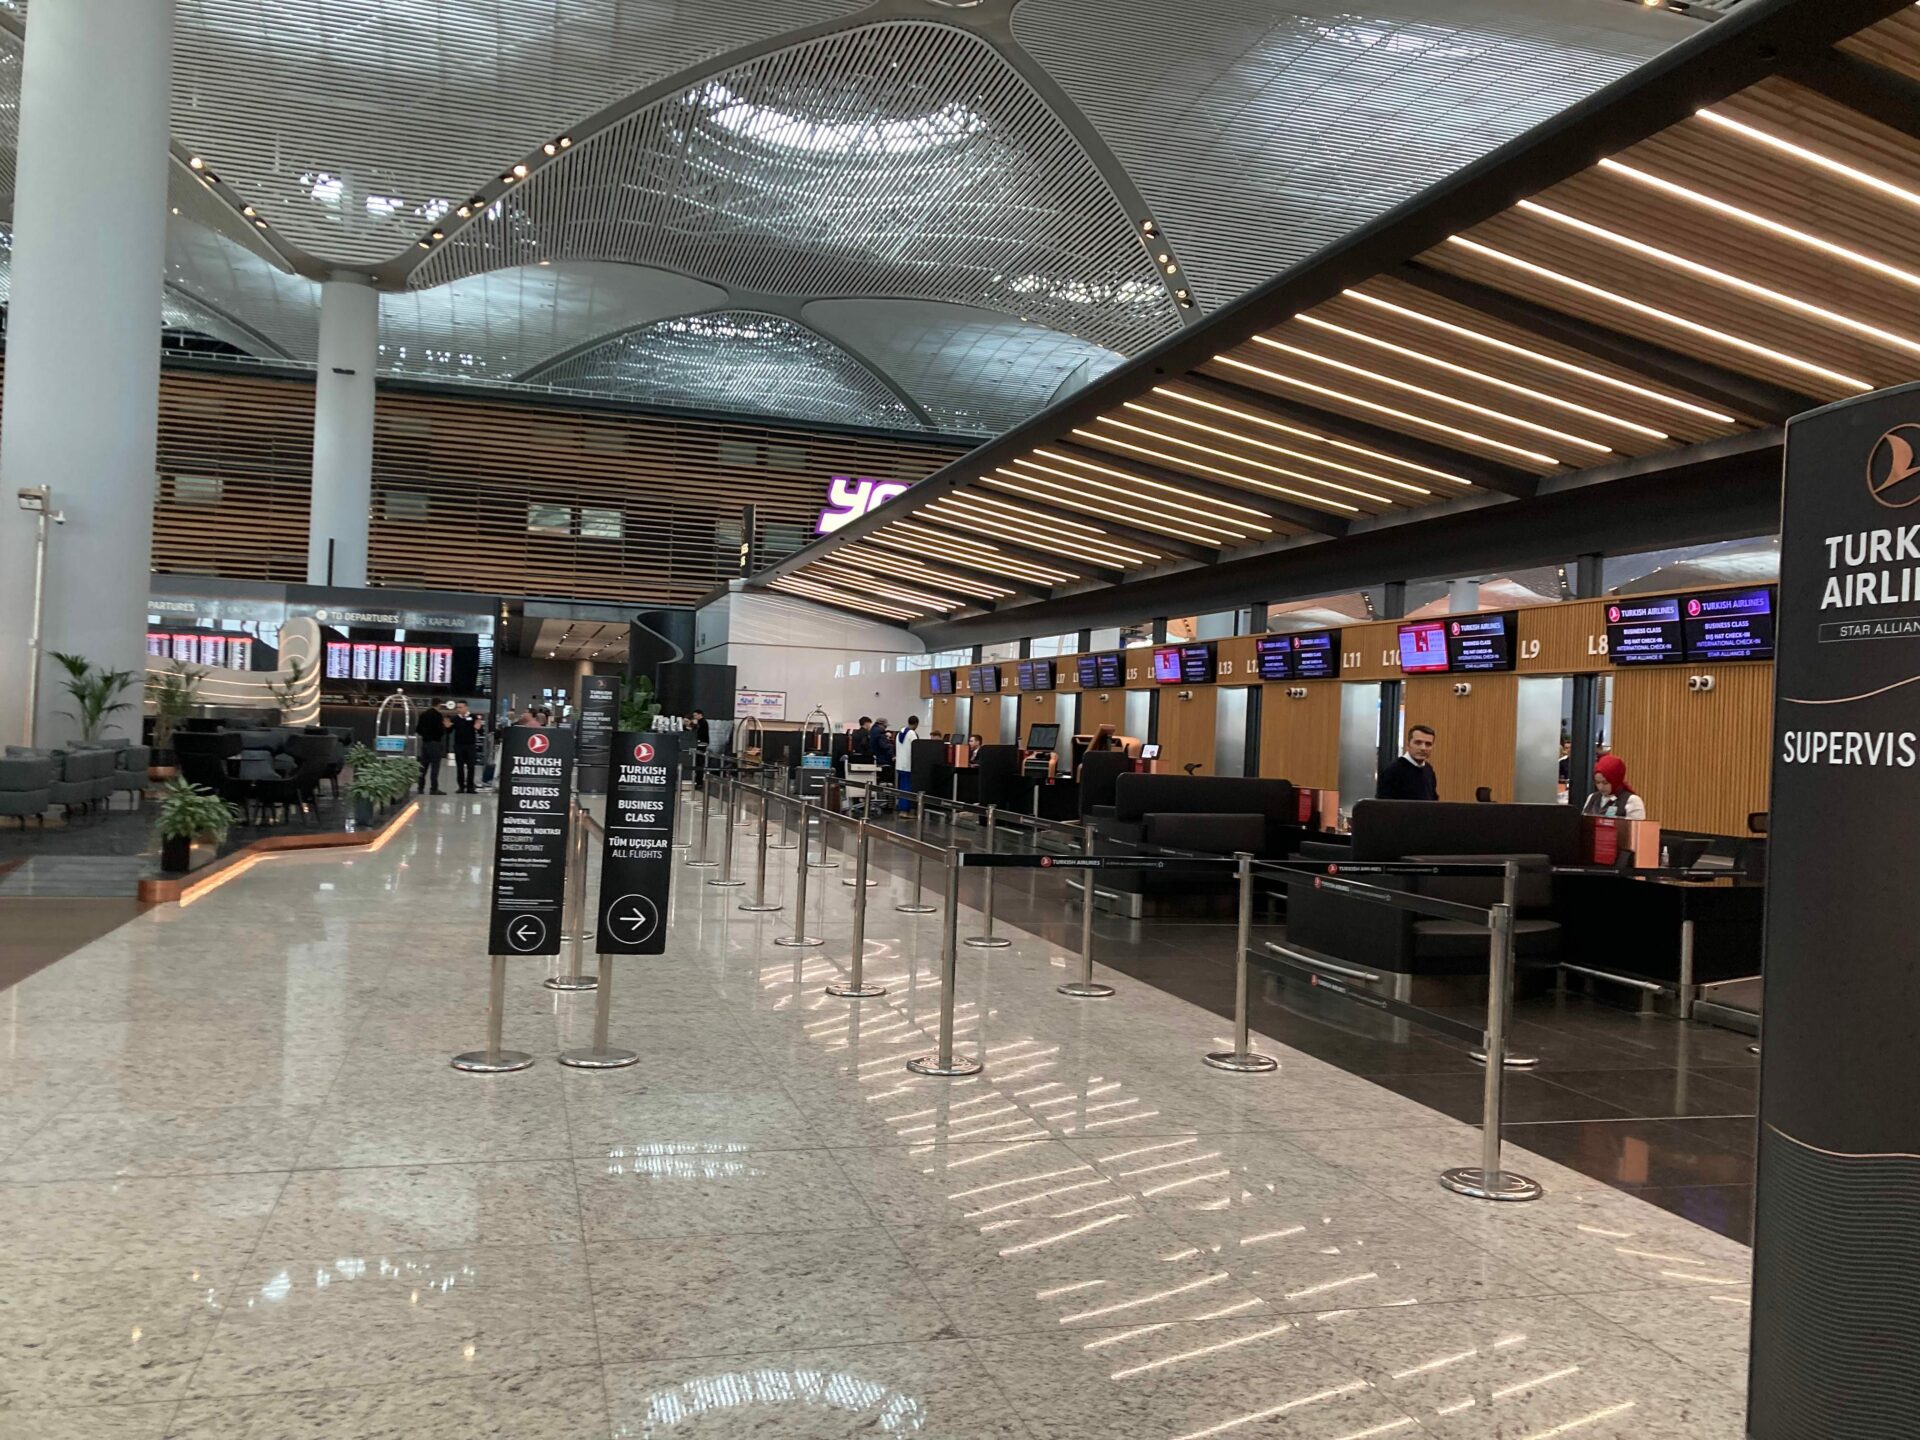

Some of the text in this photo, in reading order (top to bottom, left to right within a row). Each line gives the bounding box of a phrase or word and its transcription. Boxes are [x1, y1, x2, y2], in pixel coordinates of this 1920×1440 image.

[1702, 598, 1764, 610] TURKISH AIRLINES
[344, 612, 400, 624] DEPARTURES
[1621, 608, 1646, 617] TURKISH
[1840, 622, 1870, 637] STAR
[1521, 640, 1540, 659] L9
[1588, 635, 1608, 655] L8
[1343, 652, 1361, 668] L11
[1219, 661, 1233, 675] L13
[1127, 668, 1138, 680] L15
[1783, 730, 1916, 768] SUPERVIS
[513, 756, 562, 766] TURKISH
[512, 766, 562, 776] AIRLINES
[620, 765, 666, 775] TURKISH
[618, 775, 666, 784] AIRLINES
[512, 786, 560, 797] BUSINESS
[519, 800, 550, 809] CLASS
[618, 800, 664, 810] BUSINESS
[625, 813, 655, 822] CLASS
[609, 836, 668, 849] TÜM UÇUŞLAR
[612, 849, 662, 859] ALL FLIGHTS
